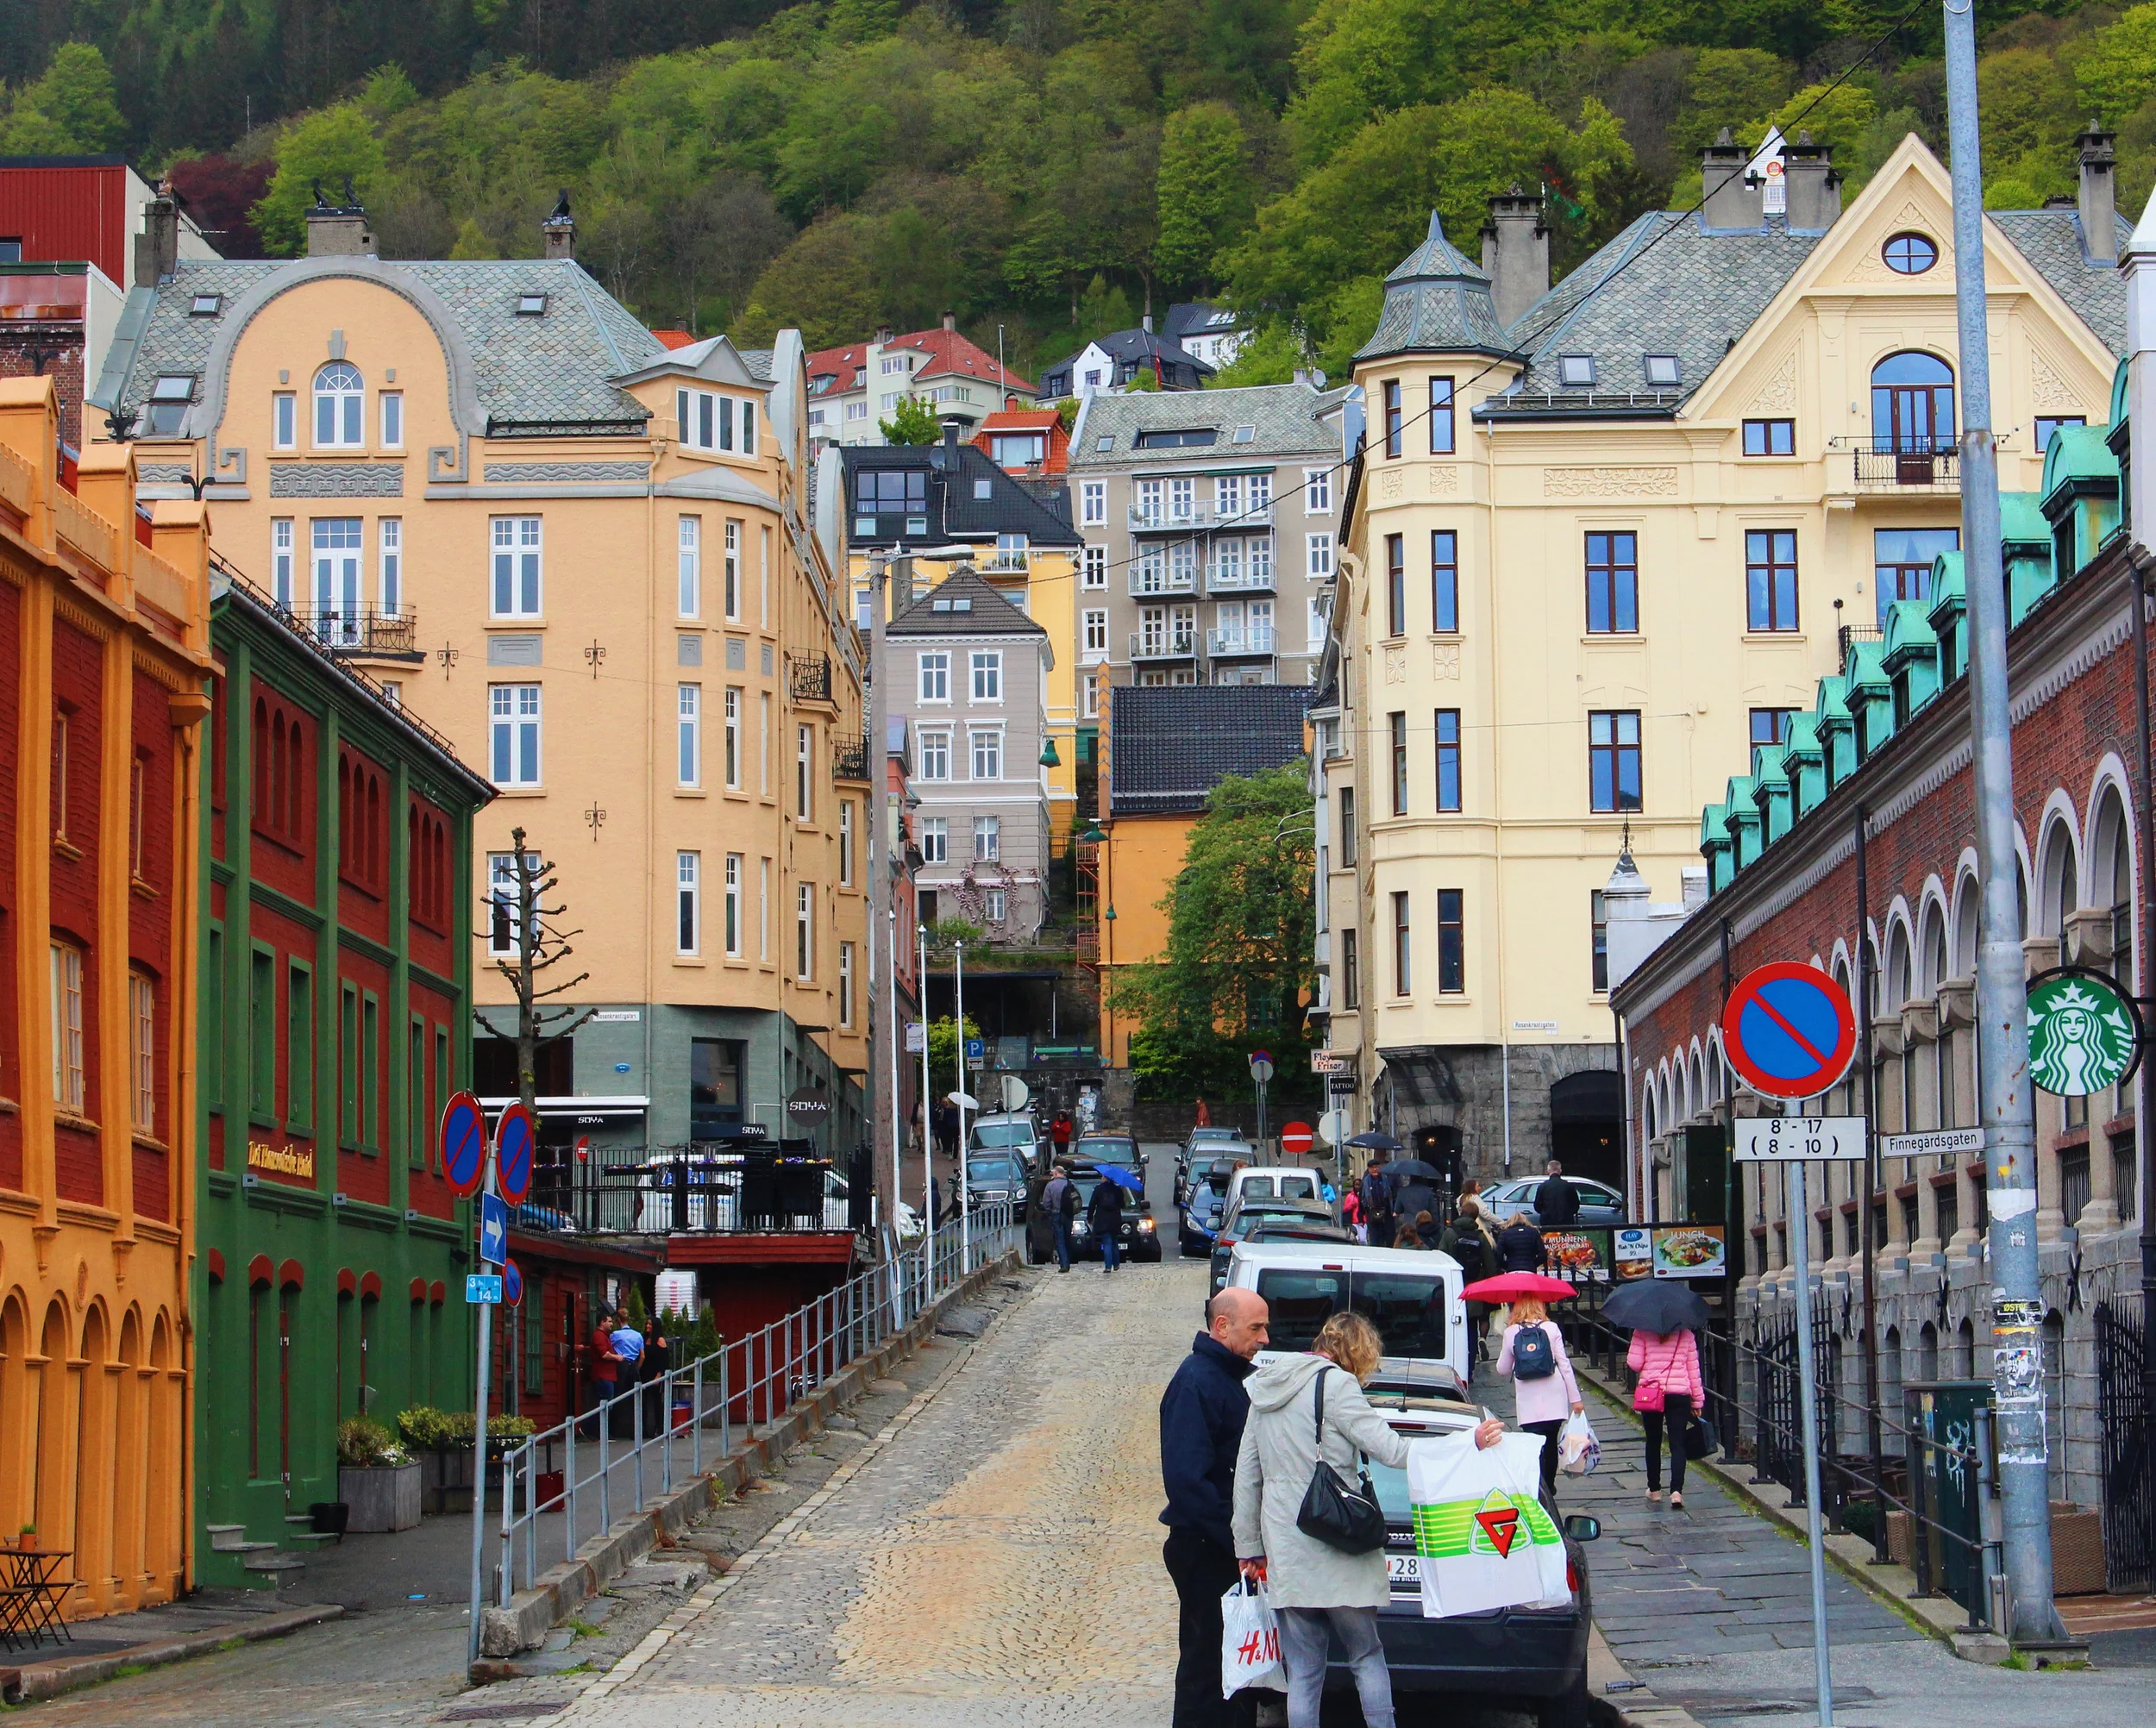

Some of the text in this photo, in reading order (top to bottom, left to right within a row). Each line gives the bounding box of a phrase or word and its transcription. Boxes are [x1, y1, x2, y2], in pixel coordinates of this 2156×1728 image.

[970, 1042, 980, 1055] P
[1331, 1082, 1355, 1091] TATTOO
[1808, 1119, 1822, 1134] 17
[1890, 1133, 1977, 1152] Finnegårdsgaten
[1670, 1230, 1705, 1240] LUNCH
[469, 1277, 476, 1287] 3
[478, 1290, 492, 1301] 14
[1395, 1558, 1417, 1575] 28
[1237, 1627, 1281, 1666] H&M
